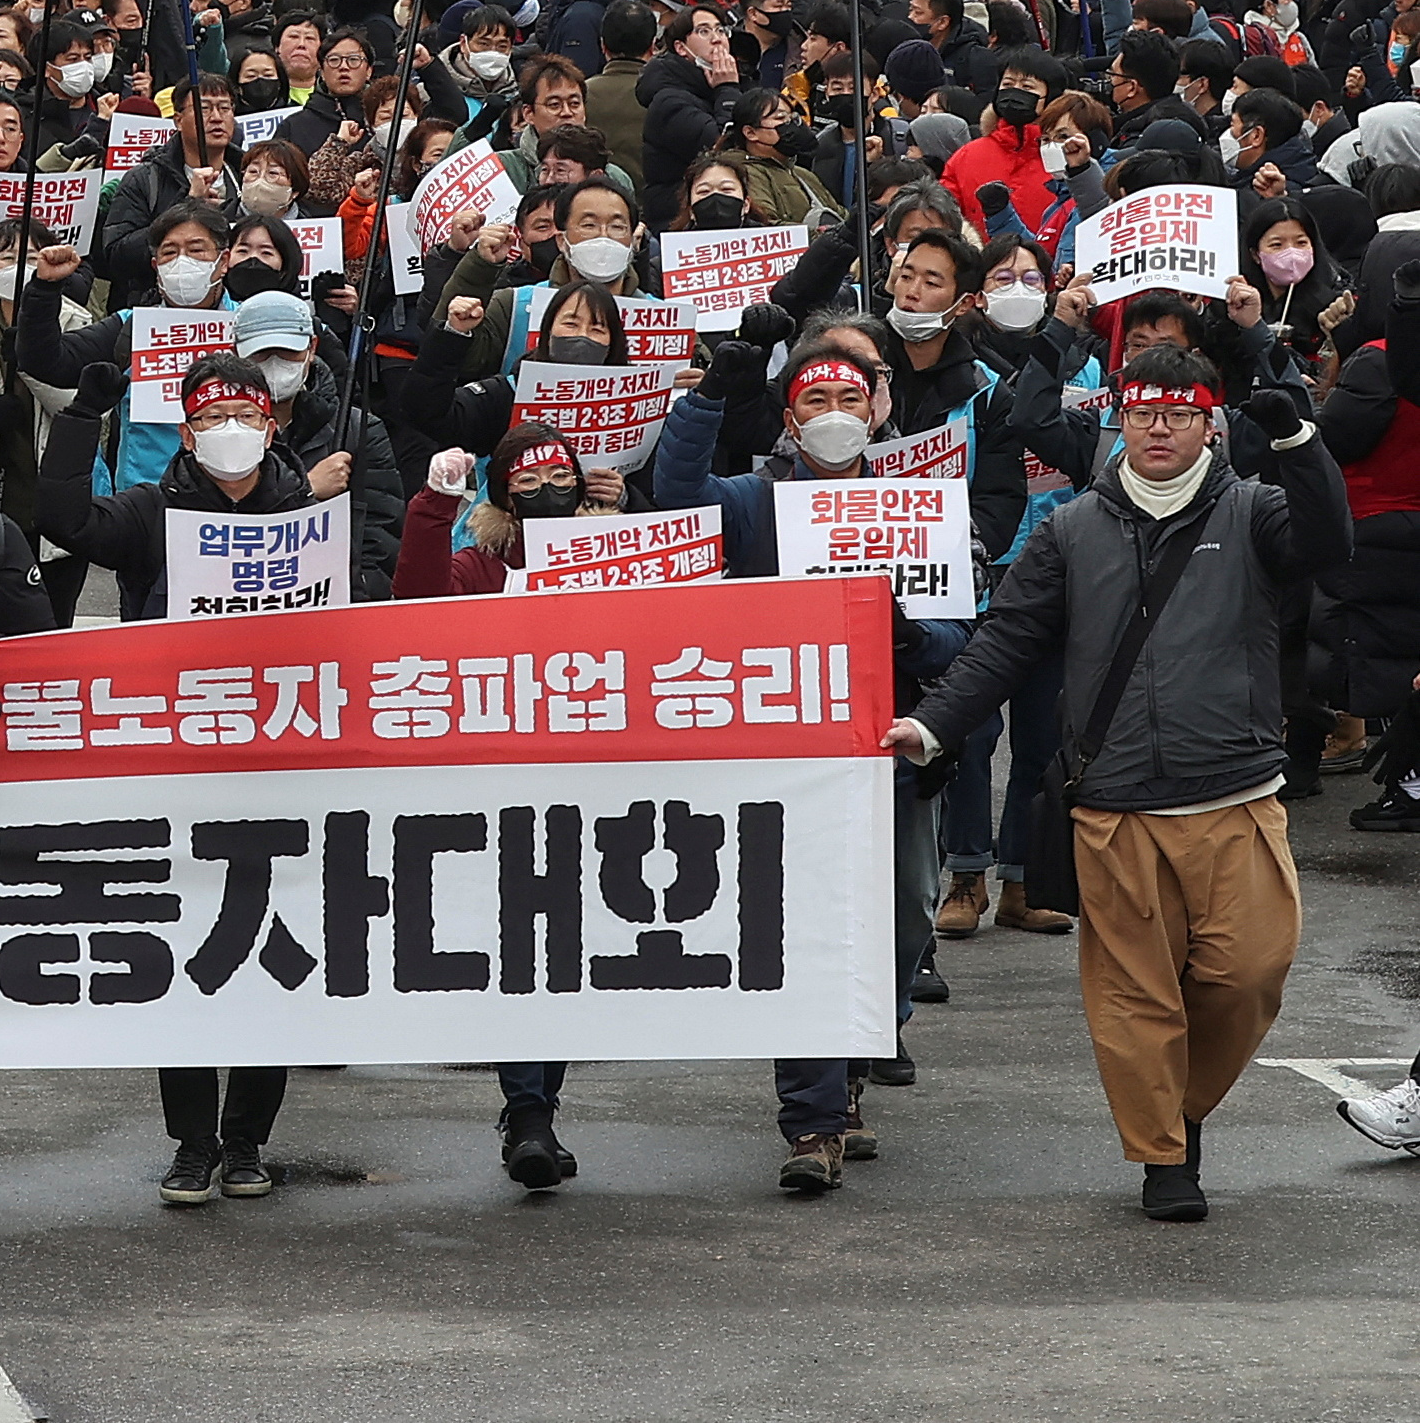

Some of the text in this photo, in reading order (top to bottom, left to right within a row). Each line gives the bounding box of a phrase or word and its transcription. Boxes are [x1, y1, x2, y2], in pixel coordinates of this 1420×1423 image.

[1098, 192, 1213, 238] 화물안전
[677, 231, 792, 268] 노동개악 저지!
[1110, 220, 1197, 255] 운임제
[670, 269, 719, 293] 노조법
[1091, 246, 1216, 284] 확대하라!
[692, 287, 745, 314] 민영화
[150, 321, 225, 348] 노동개악
[645, 335, 688, 357] 개정!
[535, 370, 659, 401] 노동개악 저지!
[631, 395, 666, 419] 개정!
[605, 428, 644, 453] 중단!
[811, 489, 944, 524] 화물안전
[199, 510, 330, 558] 업무개시
[546, 514, 701, 567] 노동개악 저지!
[827, 526, 929, 561] 운임제
[232, 556, 299, 593] 명령
[670, 543, 718, 579] 개정!
[369, 648, 628, 739] 총파업
[647, 642, 854, 729] 승리!
